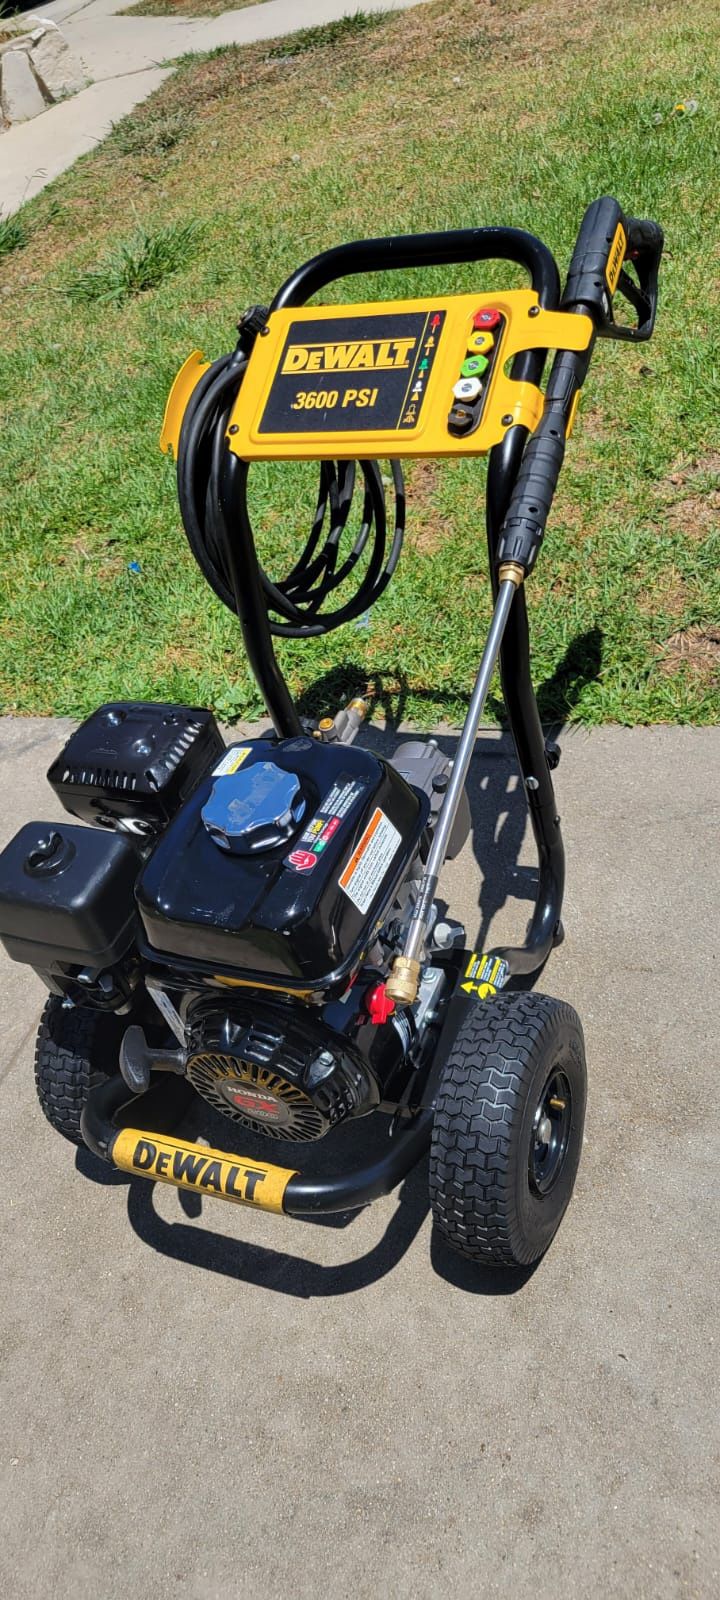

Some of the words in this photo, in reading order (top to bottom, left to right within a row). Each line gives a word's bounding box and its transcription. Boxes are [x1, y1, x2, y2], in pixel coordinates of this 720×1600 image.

[281, 341, 416, 372] DEWALT
[293, 390, 339, 410] 3600
[341, 388, 379, 408] PSI
[226, 1086, 279, 1103] HONDA
[233, 1095, 279, 1112] GX
[132, 1139, 267, 1201] DEWALT
